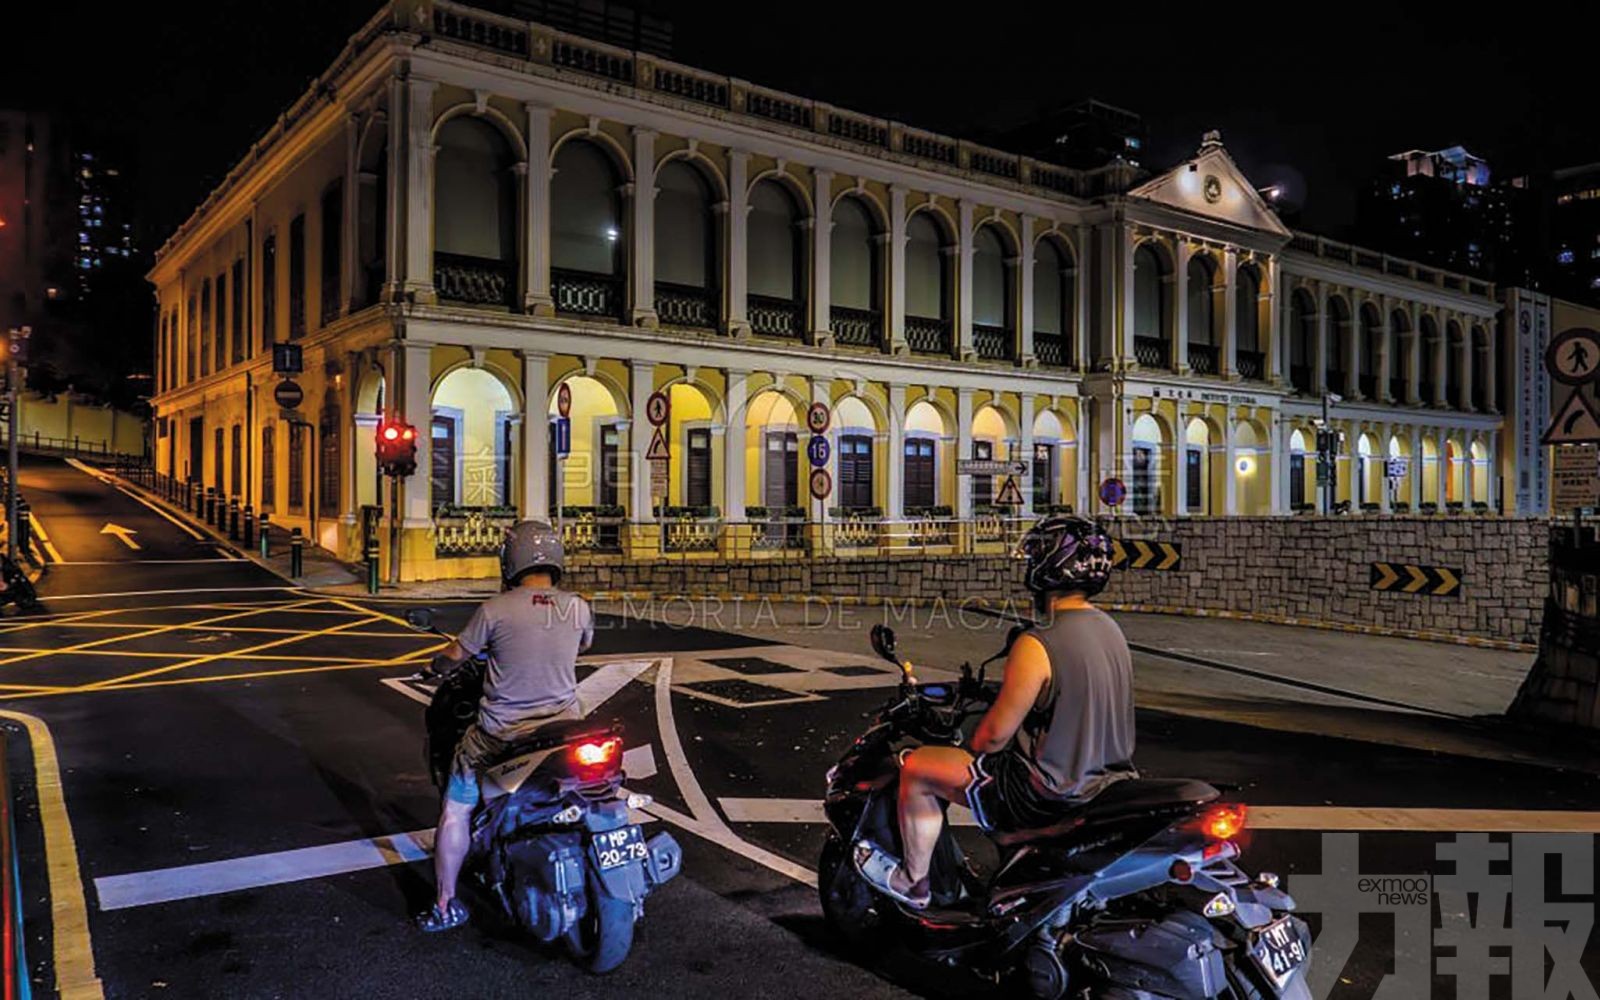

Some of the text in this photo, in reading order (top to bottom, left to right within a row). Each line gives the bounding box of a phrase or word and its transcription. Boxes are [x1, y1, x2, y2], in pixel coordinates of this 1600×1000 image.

[600, 842, 647, 866] 20-73
[1270, 922, 1290, 947] MT
[1274, 939, 1306, 972] 41-91
